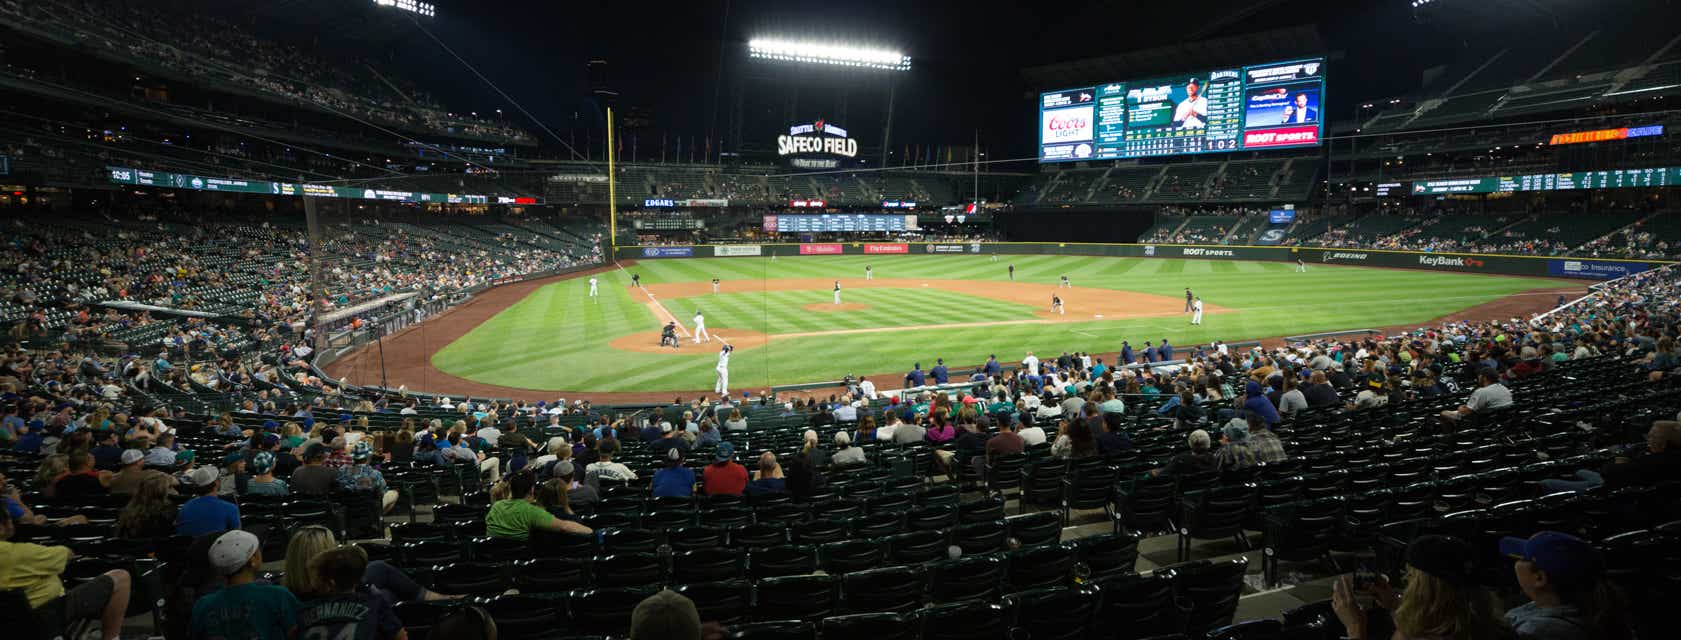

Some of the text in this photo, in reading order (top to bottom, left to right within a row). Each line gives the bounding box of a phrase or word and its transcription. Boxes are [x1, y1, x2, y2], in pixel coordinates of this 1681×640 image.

[1049, 117, 1086, 131] Coors
[778, 135, 857, 157] SAFECO FIELD
[1419, 255, 1464, 267] KeyBank
